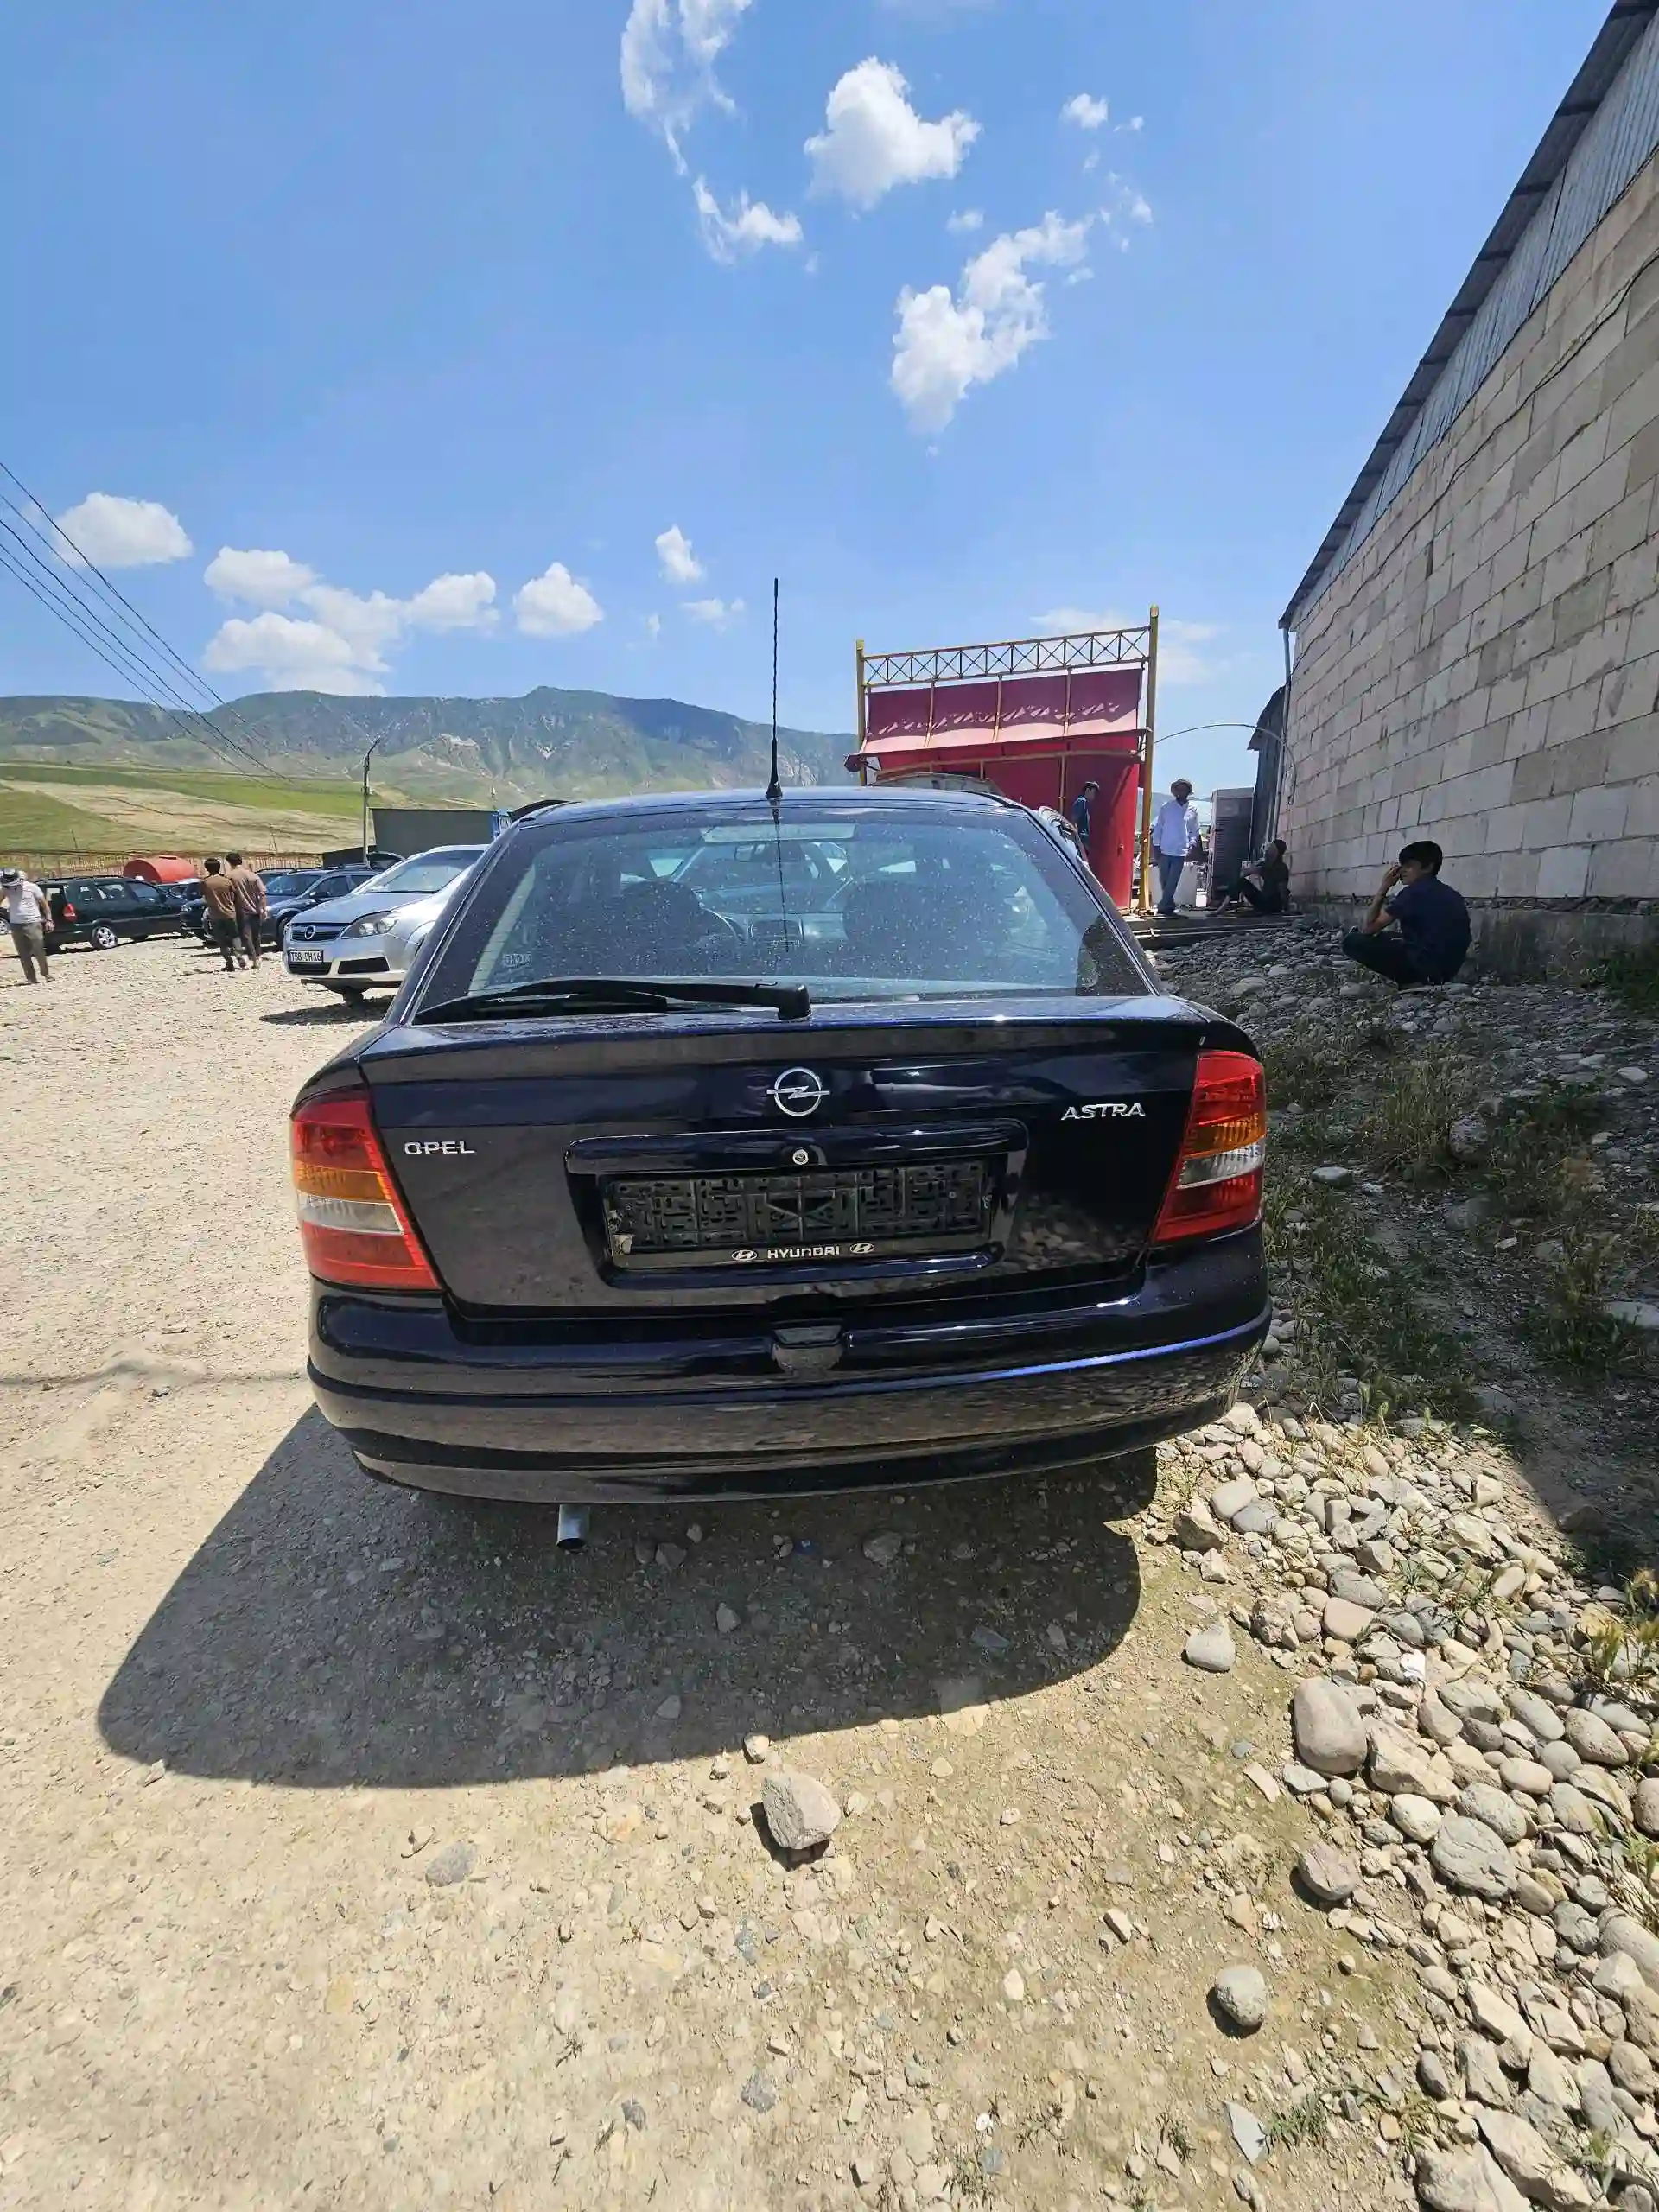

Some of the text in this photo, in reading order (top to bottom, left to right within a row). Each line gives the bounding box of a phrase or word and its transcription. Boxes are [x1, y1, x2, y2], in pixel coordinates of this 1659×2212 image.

[1060, 1103, 1146, 1121] ASTRA
[404, 1141, 477, 1154] OPEL
[767, 1245, 840, 1259] HYUNDAI
